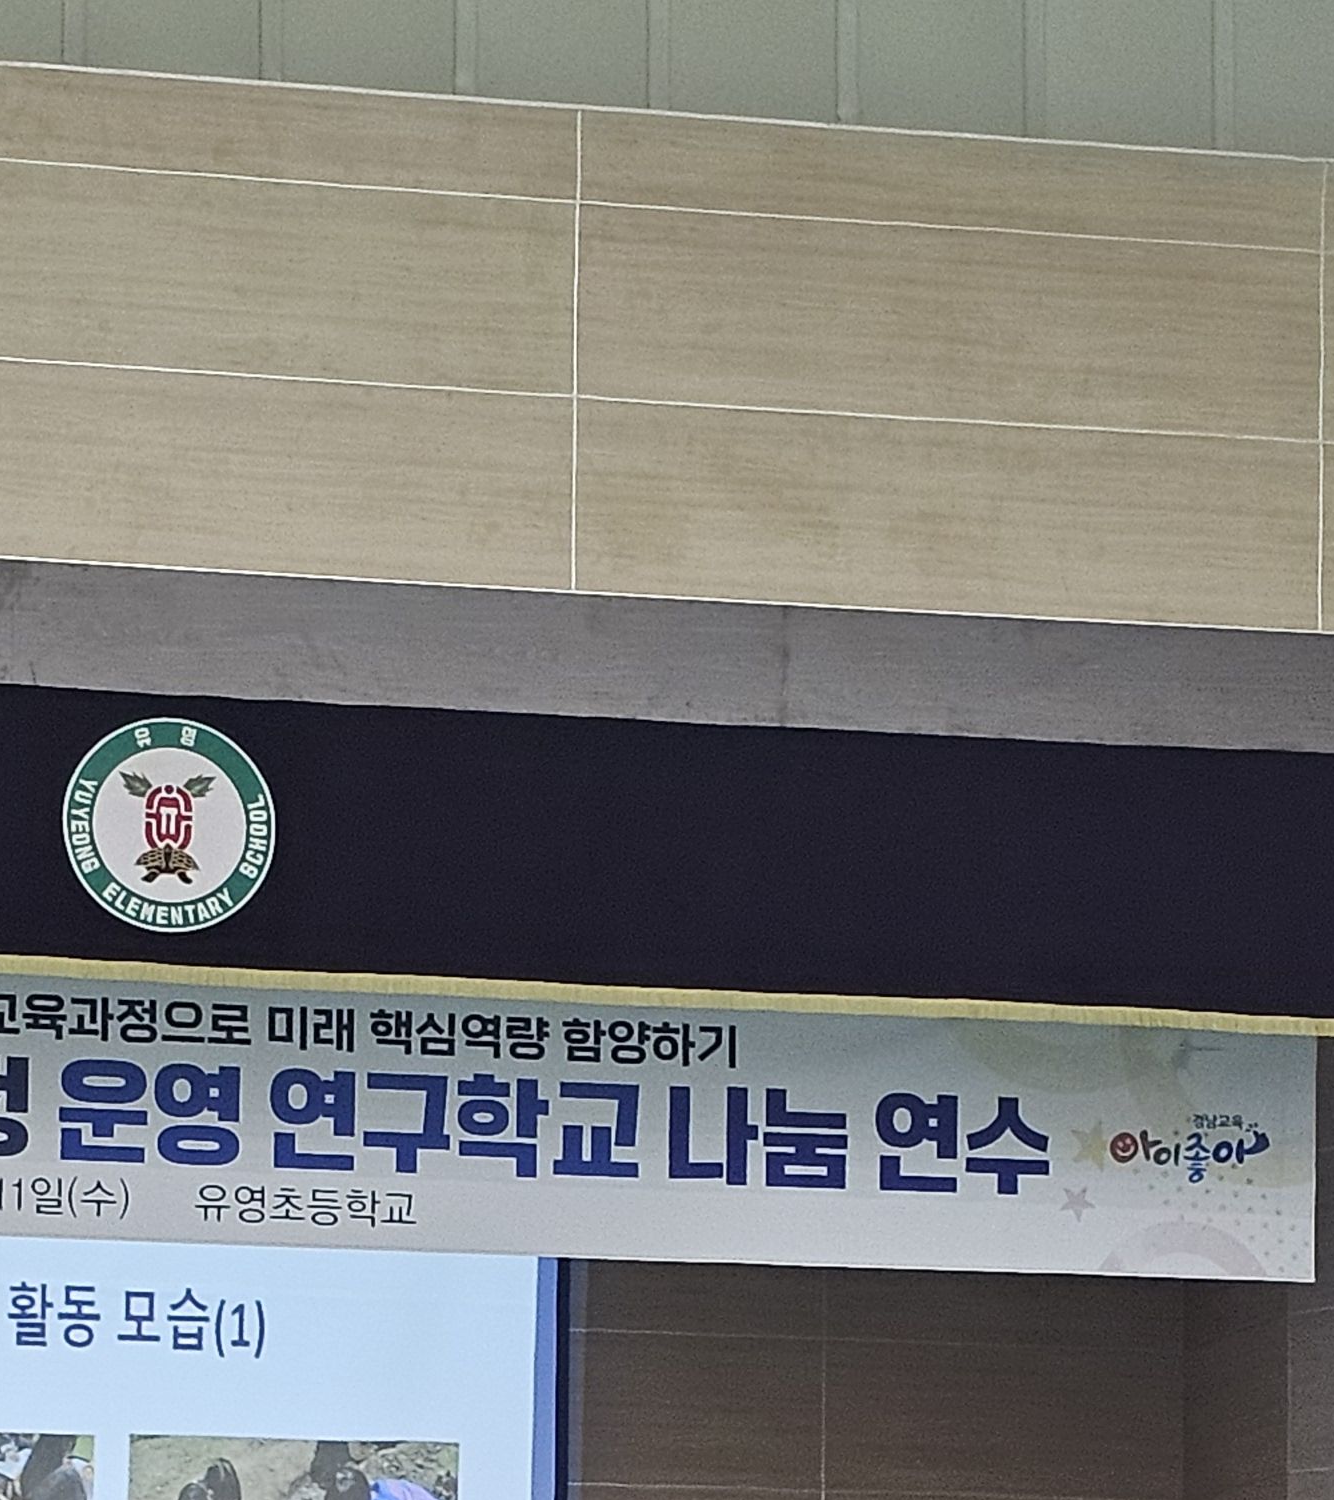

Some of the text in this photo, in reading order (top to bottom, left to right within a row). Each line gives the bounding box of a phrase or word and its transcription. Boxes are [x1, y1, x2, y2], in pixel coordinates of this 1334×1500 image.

[70, 778, 268, 925] YUYEONG ELEMENTARY SCHOOL
[267, 1005, 355, 1053] 미래
[369, 1008, 551, 1061] 핵심역량
[562, 1017, 737, 1069] 함양하기
[58, 1058, 241, 1166] 운영
[269, 1067, 640, 1179] 연구학교
[668, 1085, 849, 1190] 나눔
[875, 1092, 1050, 1195] 연수
[1192, 1113, 1244, 1130] 경남교육
[1110, 1129, 1270, 1183] 아이좋아
[194, 1184, 417, 1228] 유영초등학교
[7, 1281, 101, 1348] 활동
[117, 1287, 265, 1359] 모습(1)
